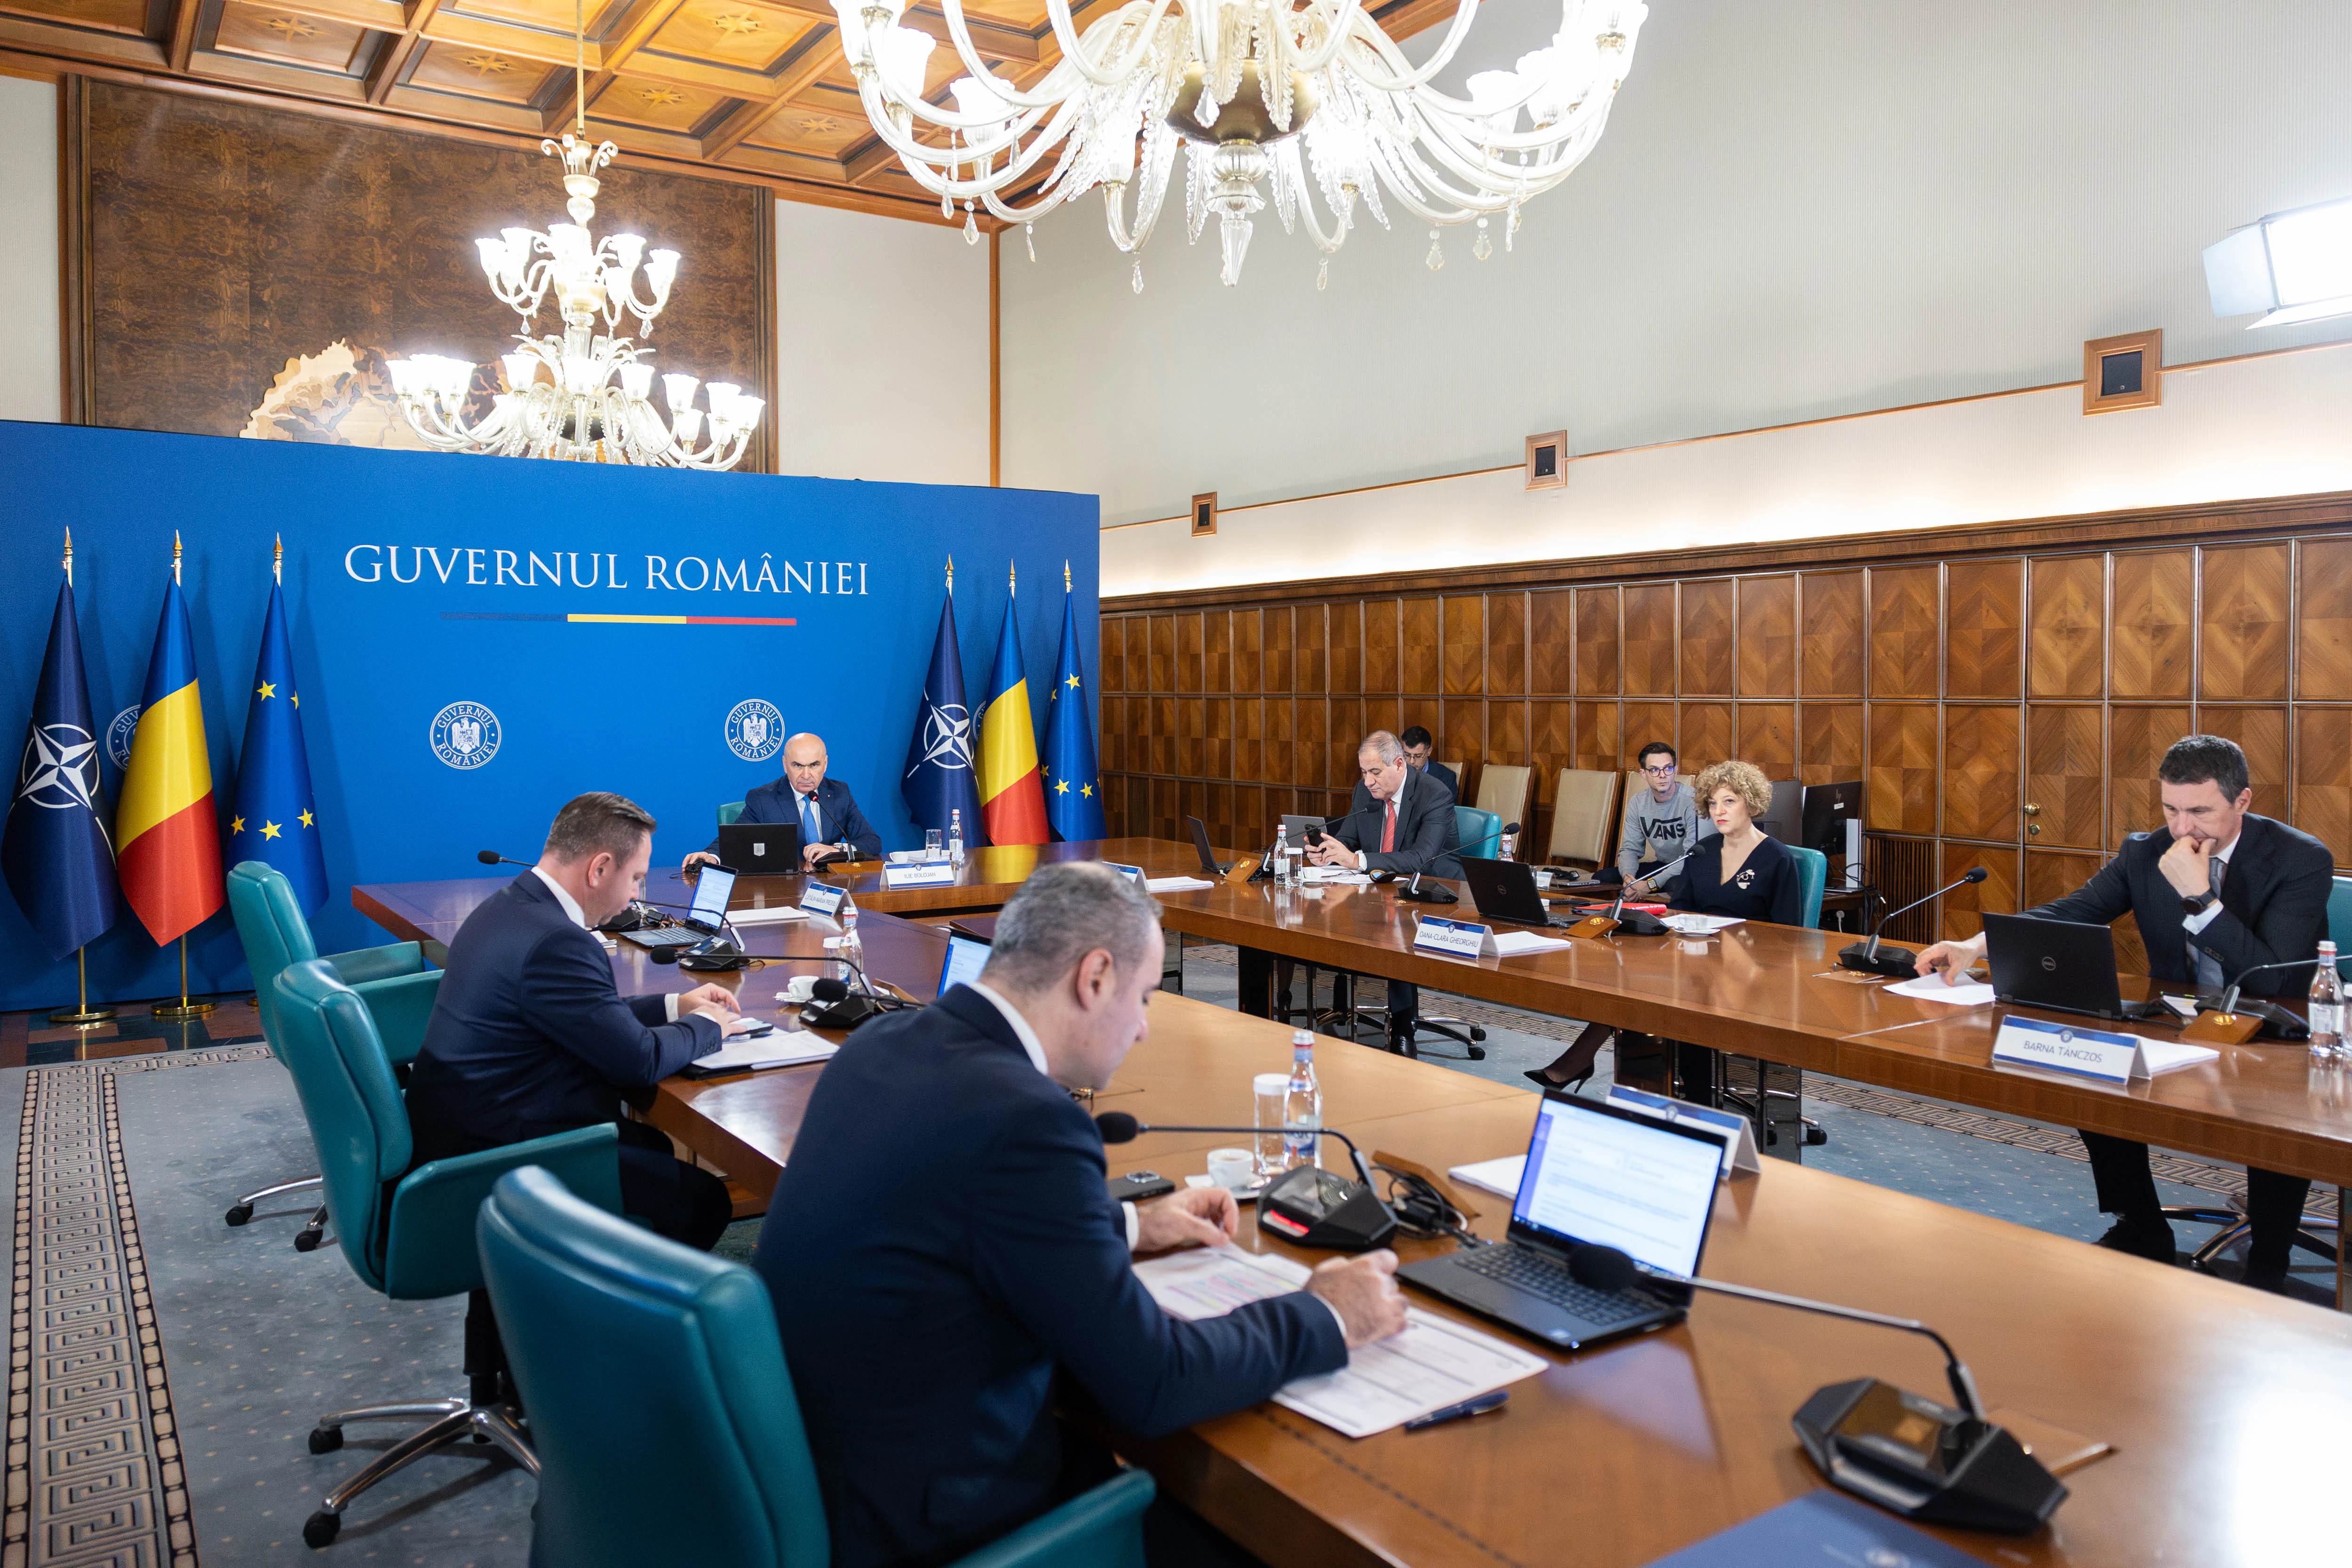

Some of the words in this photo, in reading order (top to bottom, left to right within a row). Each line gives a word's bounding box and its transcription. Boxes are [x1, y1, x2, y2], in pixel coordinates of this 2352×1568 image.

[344, 544, 628, 589] GUVERNUL
[645, 552, 869, 595] ROMÂNIEI
[437, 705, 493, 728] GUVERNUL
[731, 702, 779, 724] GUVERNUL
[437, 741, 496, 765] ROMÂNIEI
[730, 736, 780, 758] ROMÂNIEI
[1640, 816, 1685, 840] VANS
[1419, 931, 1448, 942] OANA-CLARA
[1449, 937, 1478, 947] GHEORGHIU
[2024, 1041, 2054, 1054] BARNA
